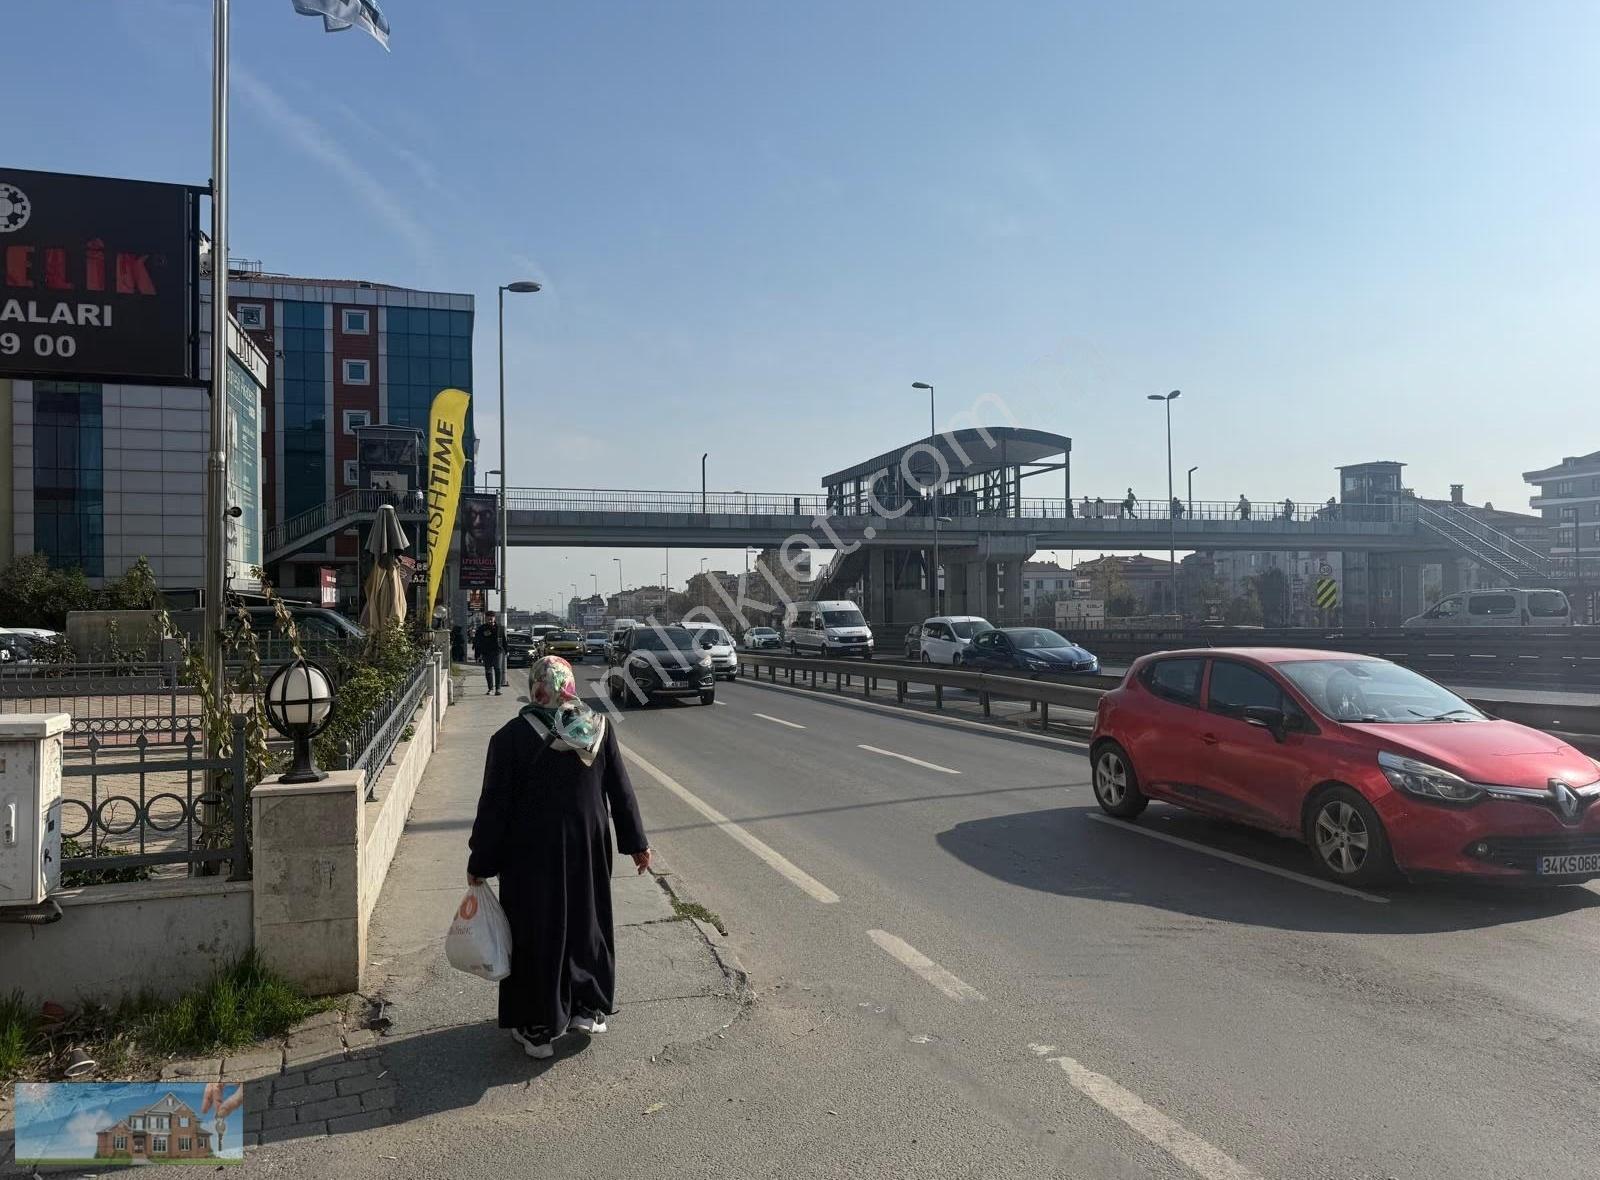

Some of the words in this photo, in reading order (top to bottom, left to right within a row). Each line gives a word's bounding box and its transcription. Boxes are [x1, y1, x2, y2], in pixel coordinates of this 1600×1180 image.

[0, 299, 113, 327] ALARI
[0, 332, 20, 355] 9
[34, 335, 77, 358] 00
